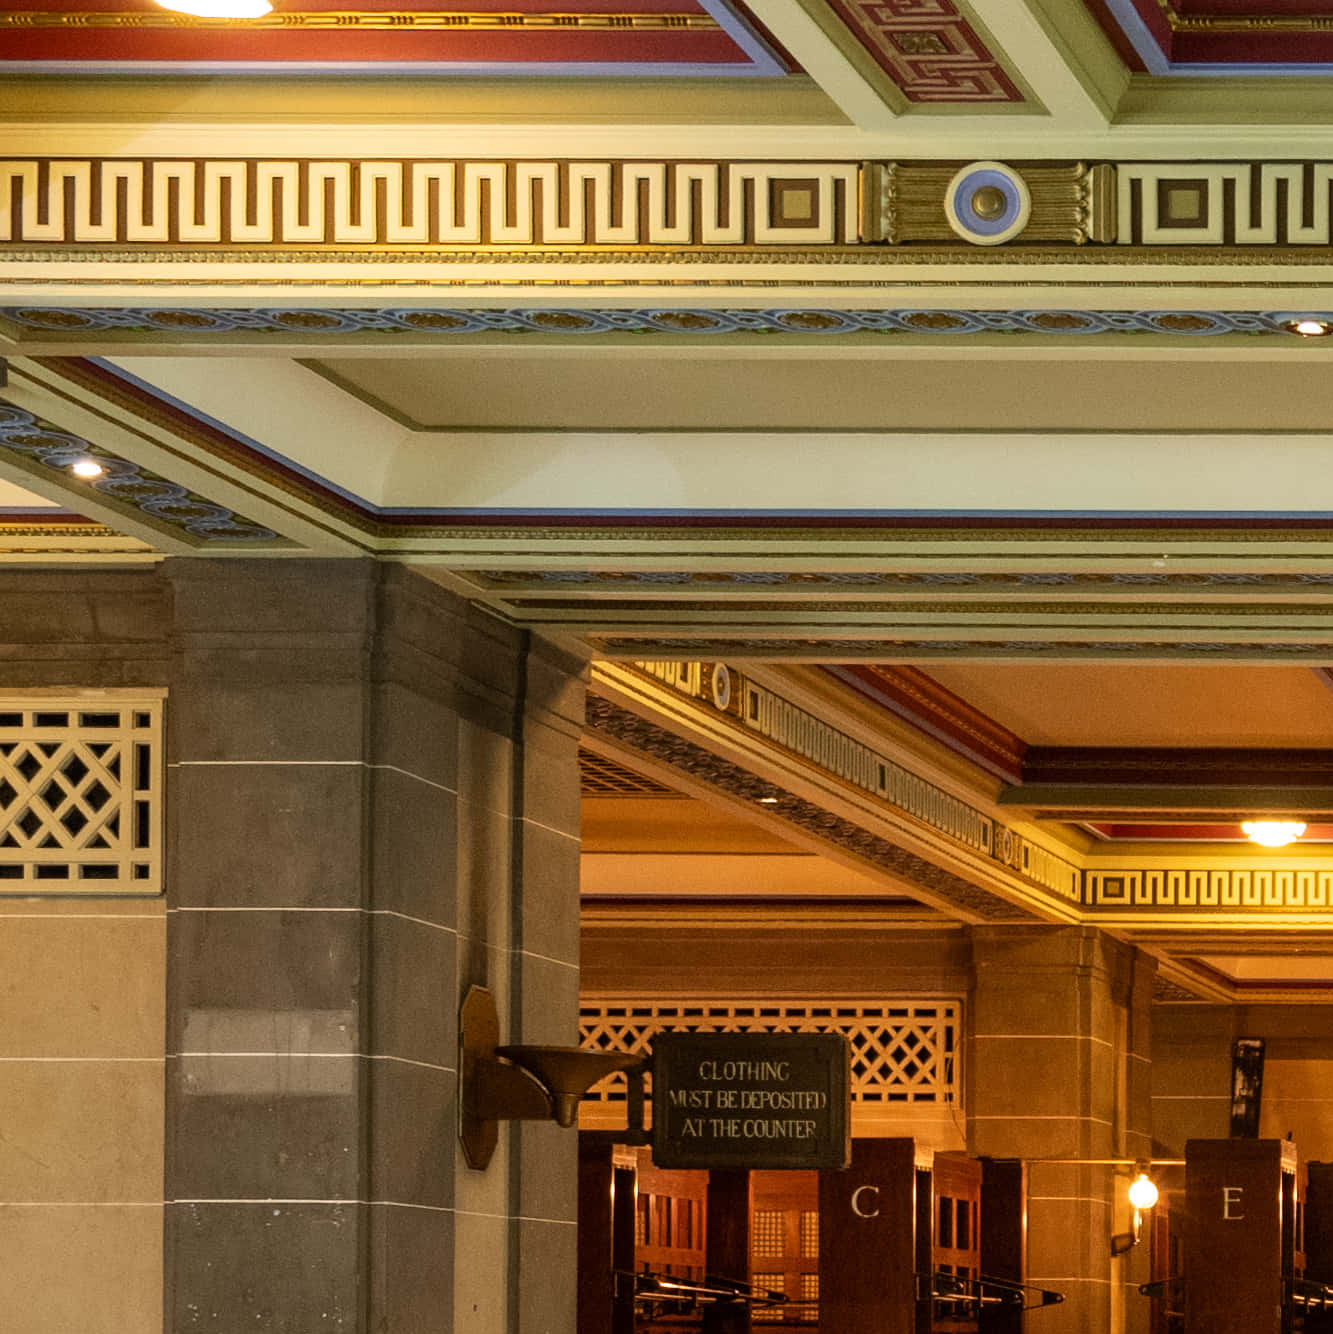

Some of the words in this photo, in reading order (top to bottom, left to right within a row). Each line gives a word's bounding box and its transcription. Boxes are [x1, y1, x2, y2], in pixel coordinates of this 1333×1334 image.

[700, 1061, 790, 1081] CLOTHING
[669, 1090, 712, 1109] MUST
[717, 1090, 738, 1109] BE
[741, 1090, 827, 1110] DEPOSITED
[682, 1119, 706, 1137] AT
[710, 1119, 741, 1138] THE
[743, 1120, 817, 1139] COUNTER
[851, 1185, 880, 1218] C
[1222, 1187, 1244, 1220] E
